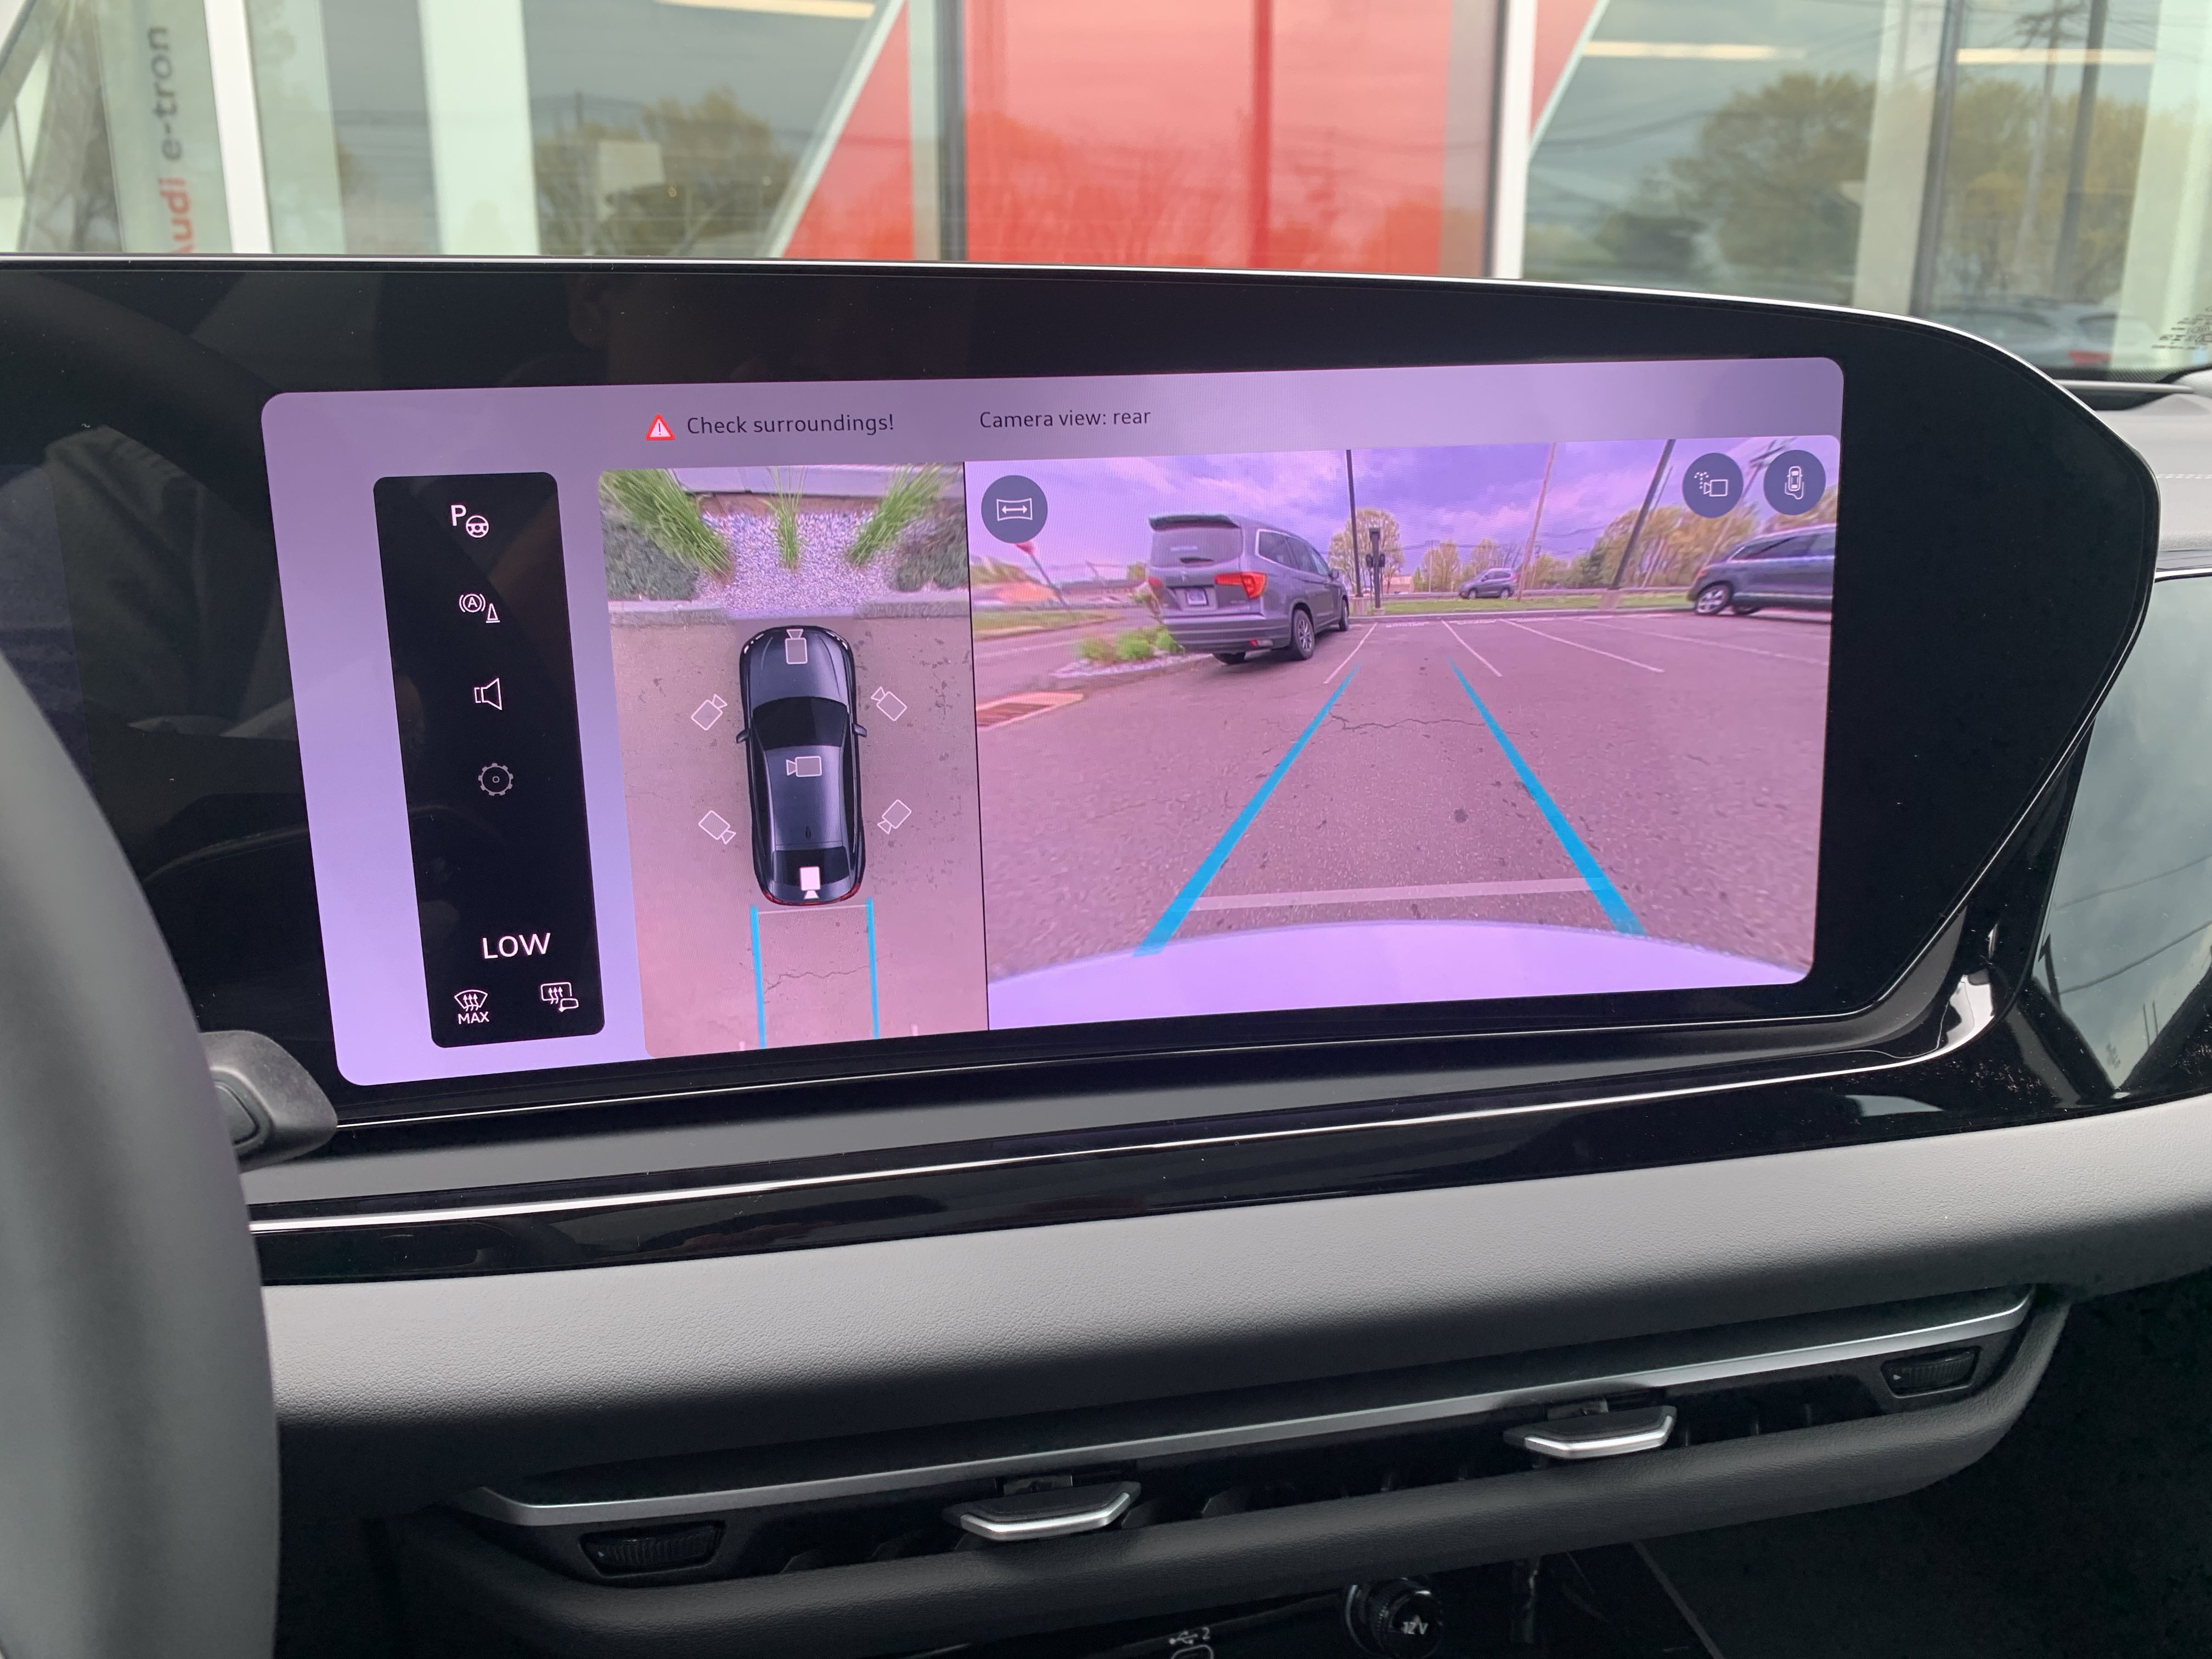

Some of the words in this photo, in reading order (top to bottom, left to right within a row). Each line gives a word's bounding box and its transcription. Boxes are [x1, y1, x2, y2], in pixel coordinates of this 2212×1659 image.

[147, 26, 183, 160] e-tron
[687, 415, 748, 435] Check
[753, 414, 894, 436] surroundings!
[979, 411, 1053, 428] Camera
[1058, 410, 1107, 426] view:
[1113, 411, 1152, 425] rear
[451, 504, 467, 527] P
[482, 932, 551, 960] LOW
[458, 1011, 490, 1025] MAX
